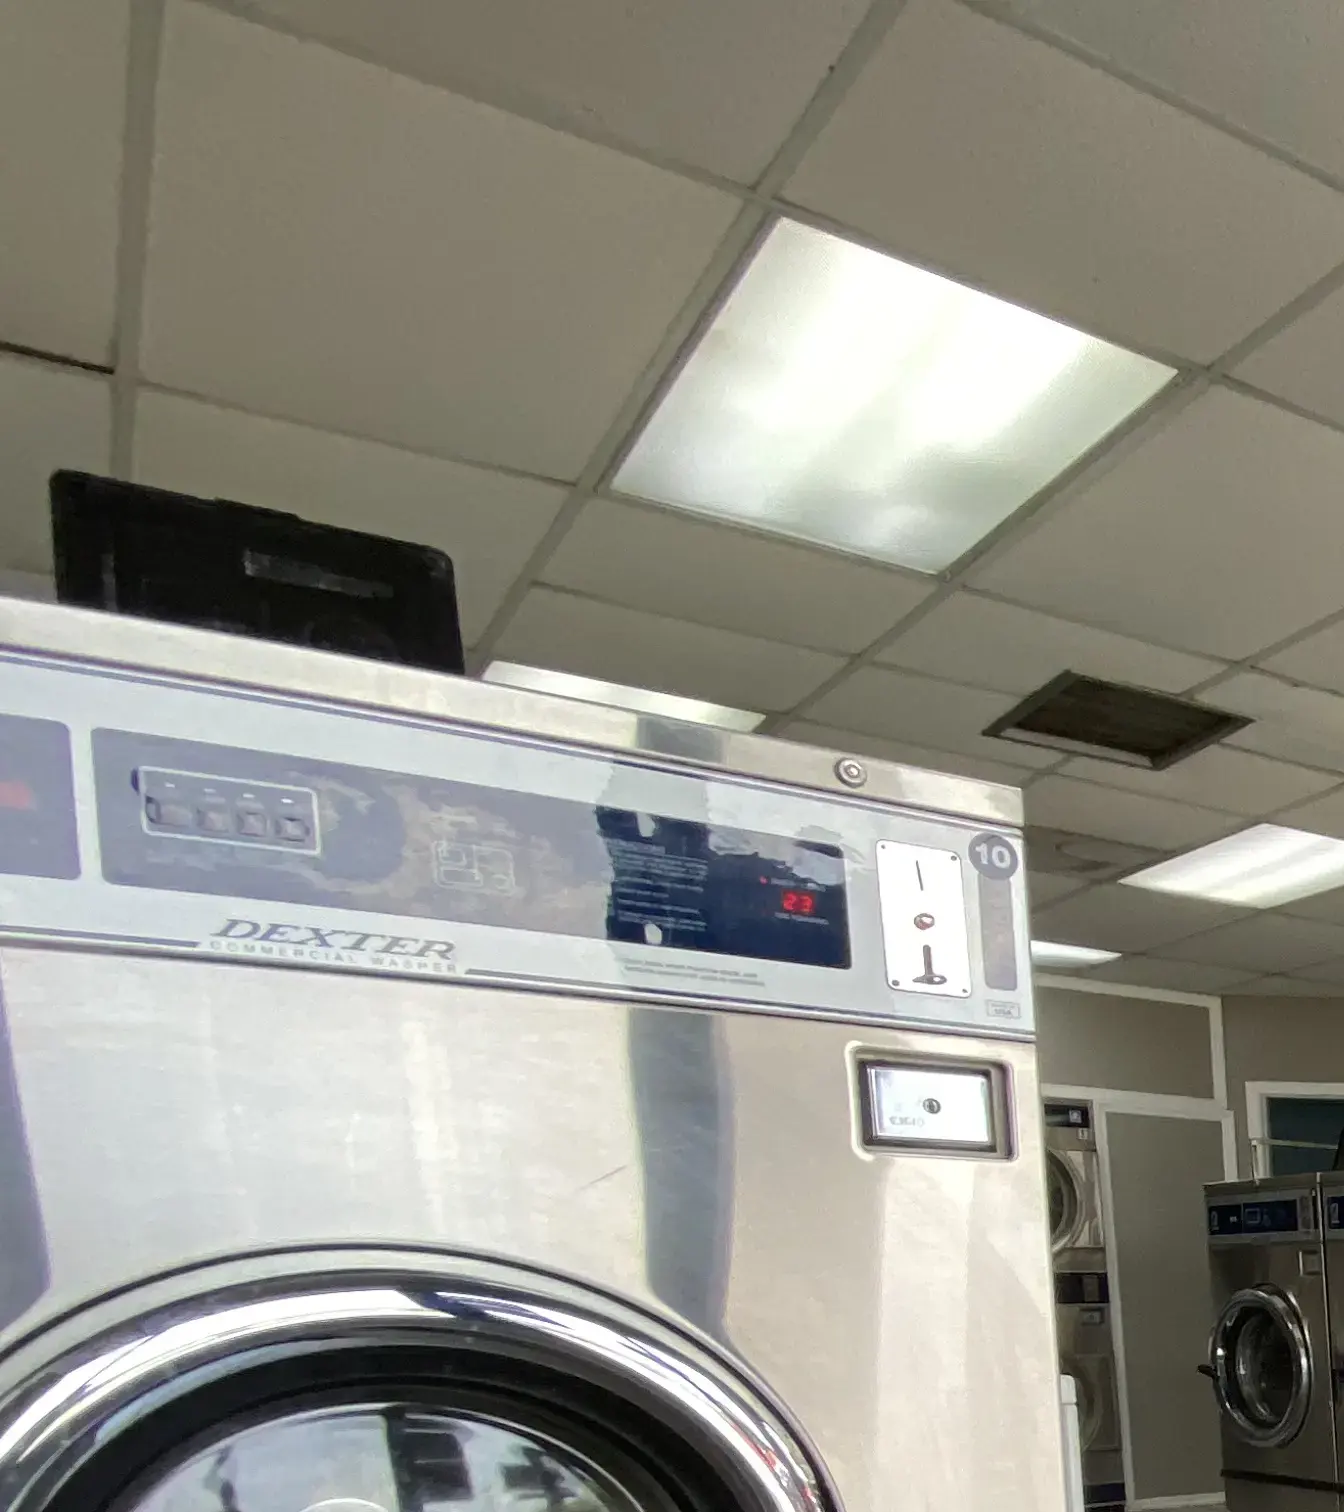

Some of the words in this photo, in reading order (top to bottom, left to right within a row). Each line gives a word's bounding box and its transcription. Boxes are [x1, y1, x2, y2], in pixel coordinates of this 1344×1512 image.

[974, 842, 1011, 869] 10
[783, 893, 813, 912] 23
[209, 918, 457, 961] DEXTER
[209, 940, 358, 964] COMMERCIAL
[371, 955, 458, 975] WASHER
